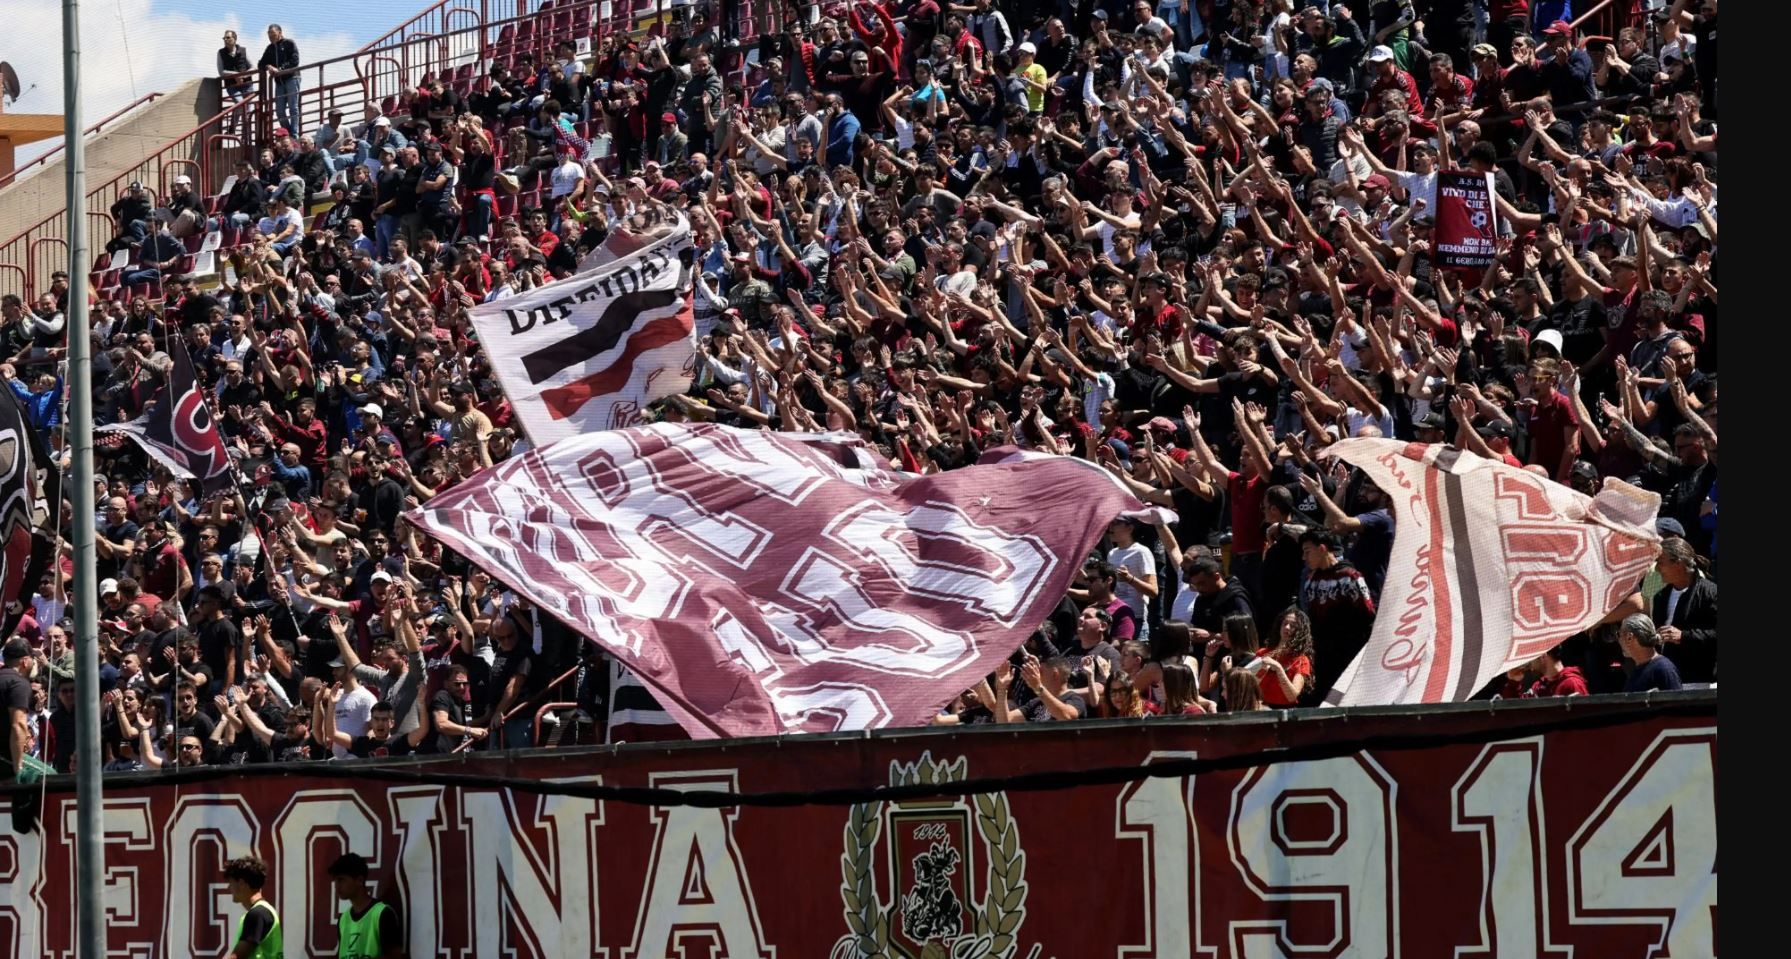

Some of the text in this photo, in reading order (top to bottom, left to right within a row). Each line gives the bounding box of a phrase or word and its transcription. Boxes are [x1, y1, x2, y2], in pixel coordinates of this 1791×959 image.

[1441, 187, 1488, 200] VIVO DI E
[1465, 199, 1485, 209] CHE
[1463, 237, 1480, 246] NON
[1487, 246, 1496, 255] DA
[913, 822, 949, 841] 1914
[1115, 726, 1717, 959] 1914
